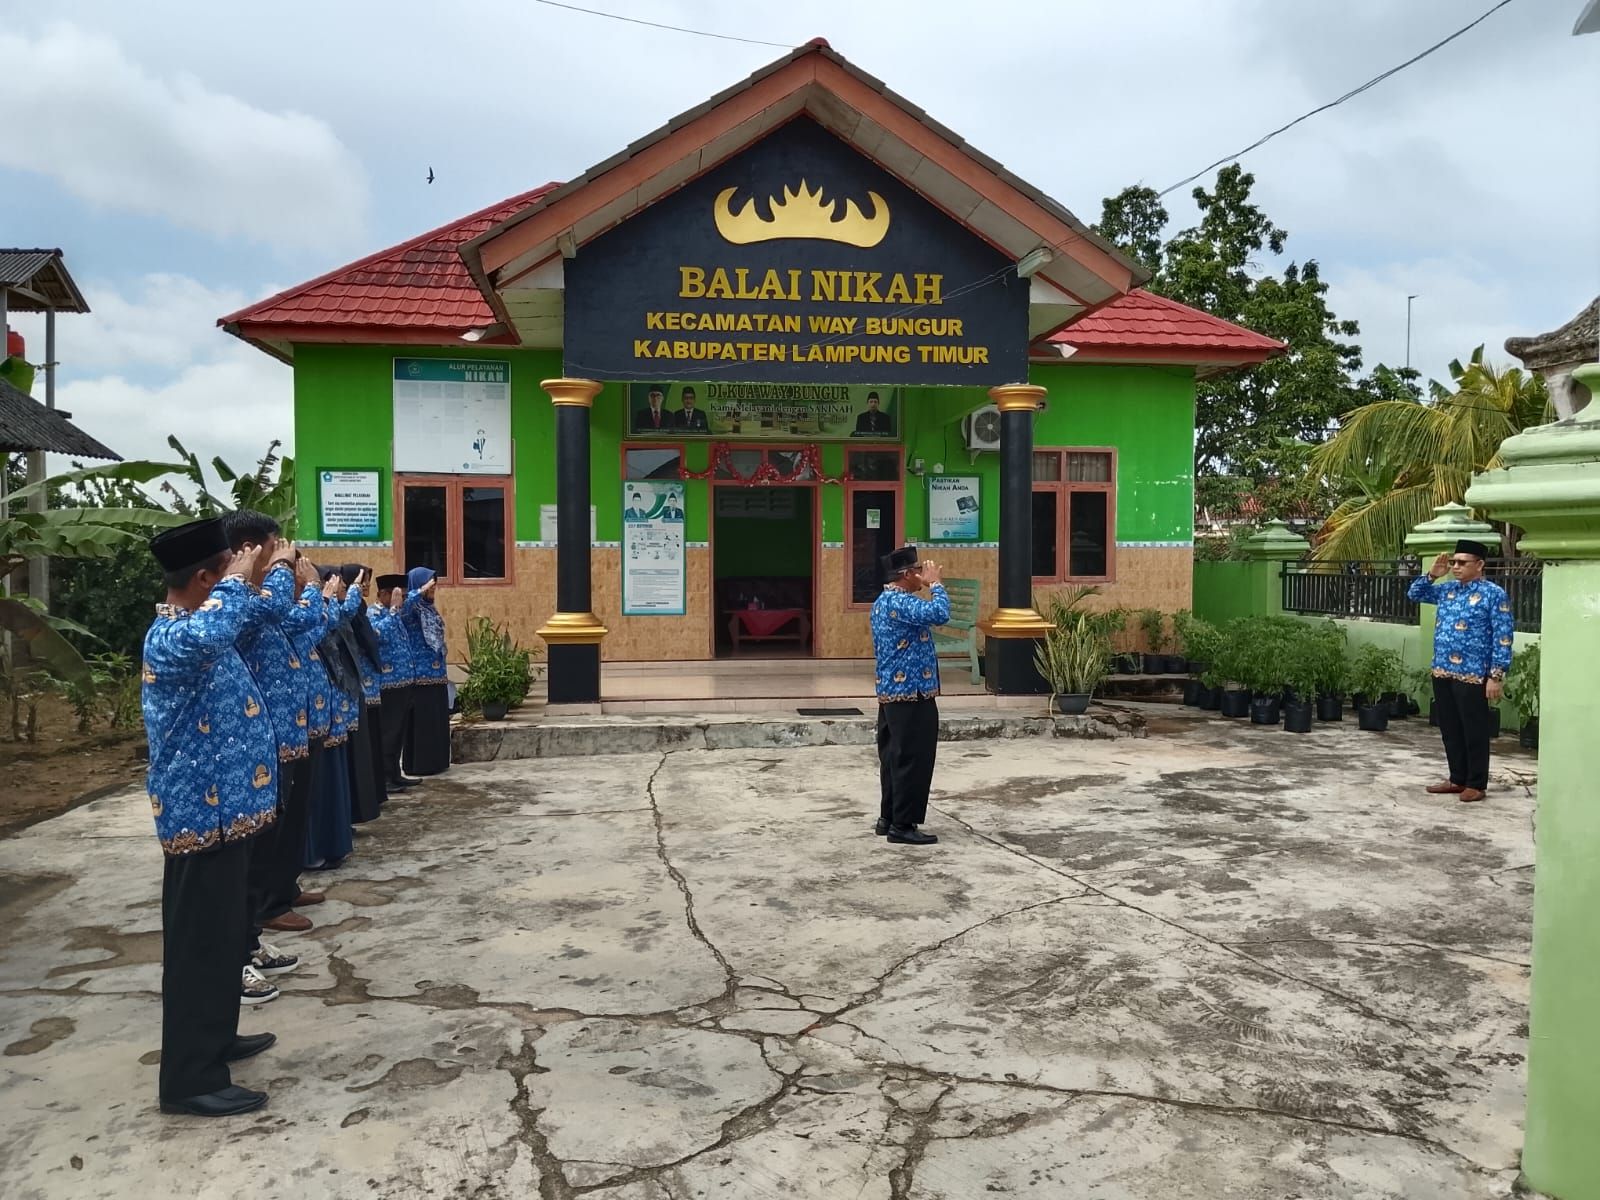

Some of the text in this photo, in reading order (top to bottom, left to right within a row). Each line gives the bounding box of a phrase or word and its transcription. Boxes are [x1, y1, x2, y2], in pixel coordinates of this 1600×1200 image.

[679, 266, 944, 305] BALAI NIKAH
[646, 312, 964, 337] KECAMATAN WAY BUNGUR
[634, 340, 990, 365] KABUPATEN LAMPUNG TIMUR
[448, 363, 466, 371] ALUR
[464, 371, 504, 382] NIKAH
[727, 384, 757, 399] KUA
[757, 385, 788, 400] WAY
[793, 385, 850, 401] BUNGUR
[710, 402, 733, 412] Kami
[808, 404, 853, 414] SAKINAH
